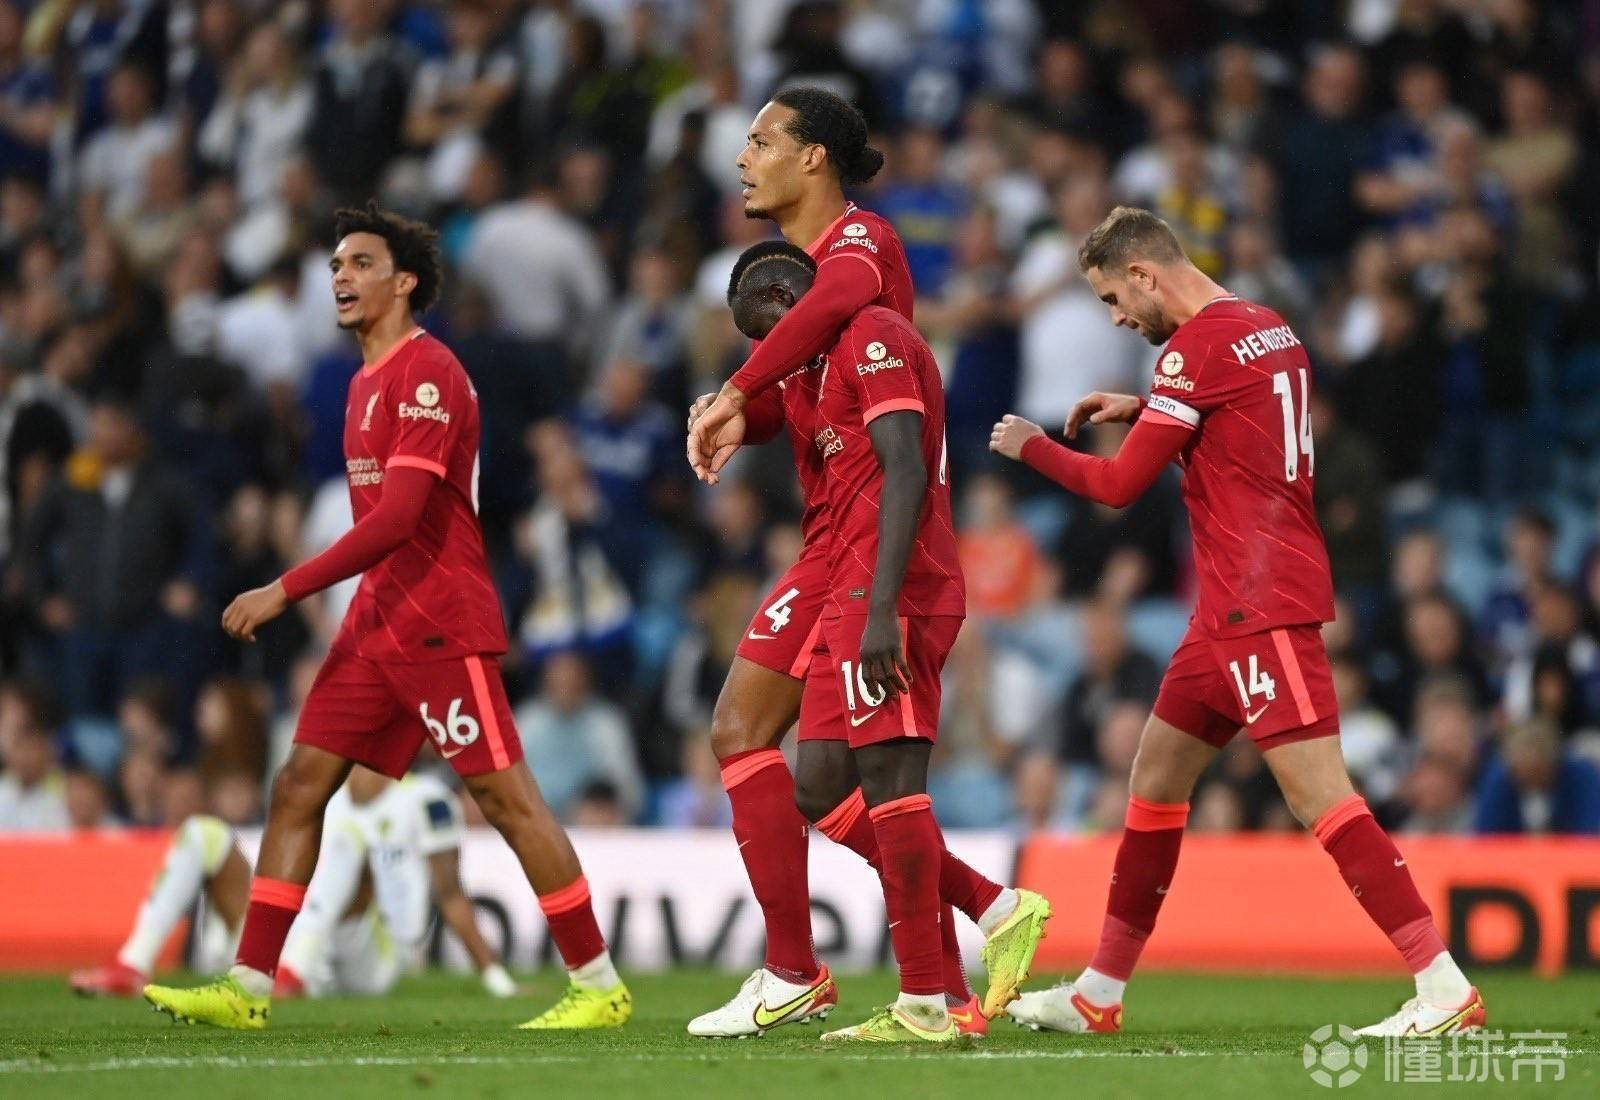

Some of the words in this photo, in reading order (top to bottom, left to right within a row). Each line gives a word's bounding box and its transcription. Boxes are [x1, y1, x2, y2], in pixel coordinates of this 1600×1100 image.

[857, 353, 904, 376] Expedia
[1153, 374, 1195, 392] pedia
[398, 402, 450, 424] Expedia
[1273, 368, 1314, 482] 14
[764, 587, 801, 633] 4
[1229, 654, 1276, 709] 14
[419, 697, 480, 746] 66
